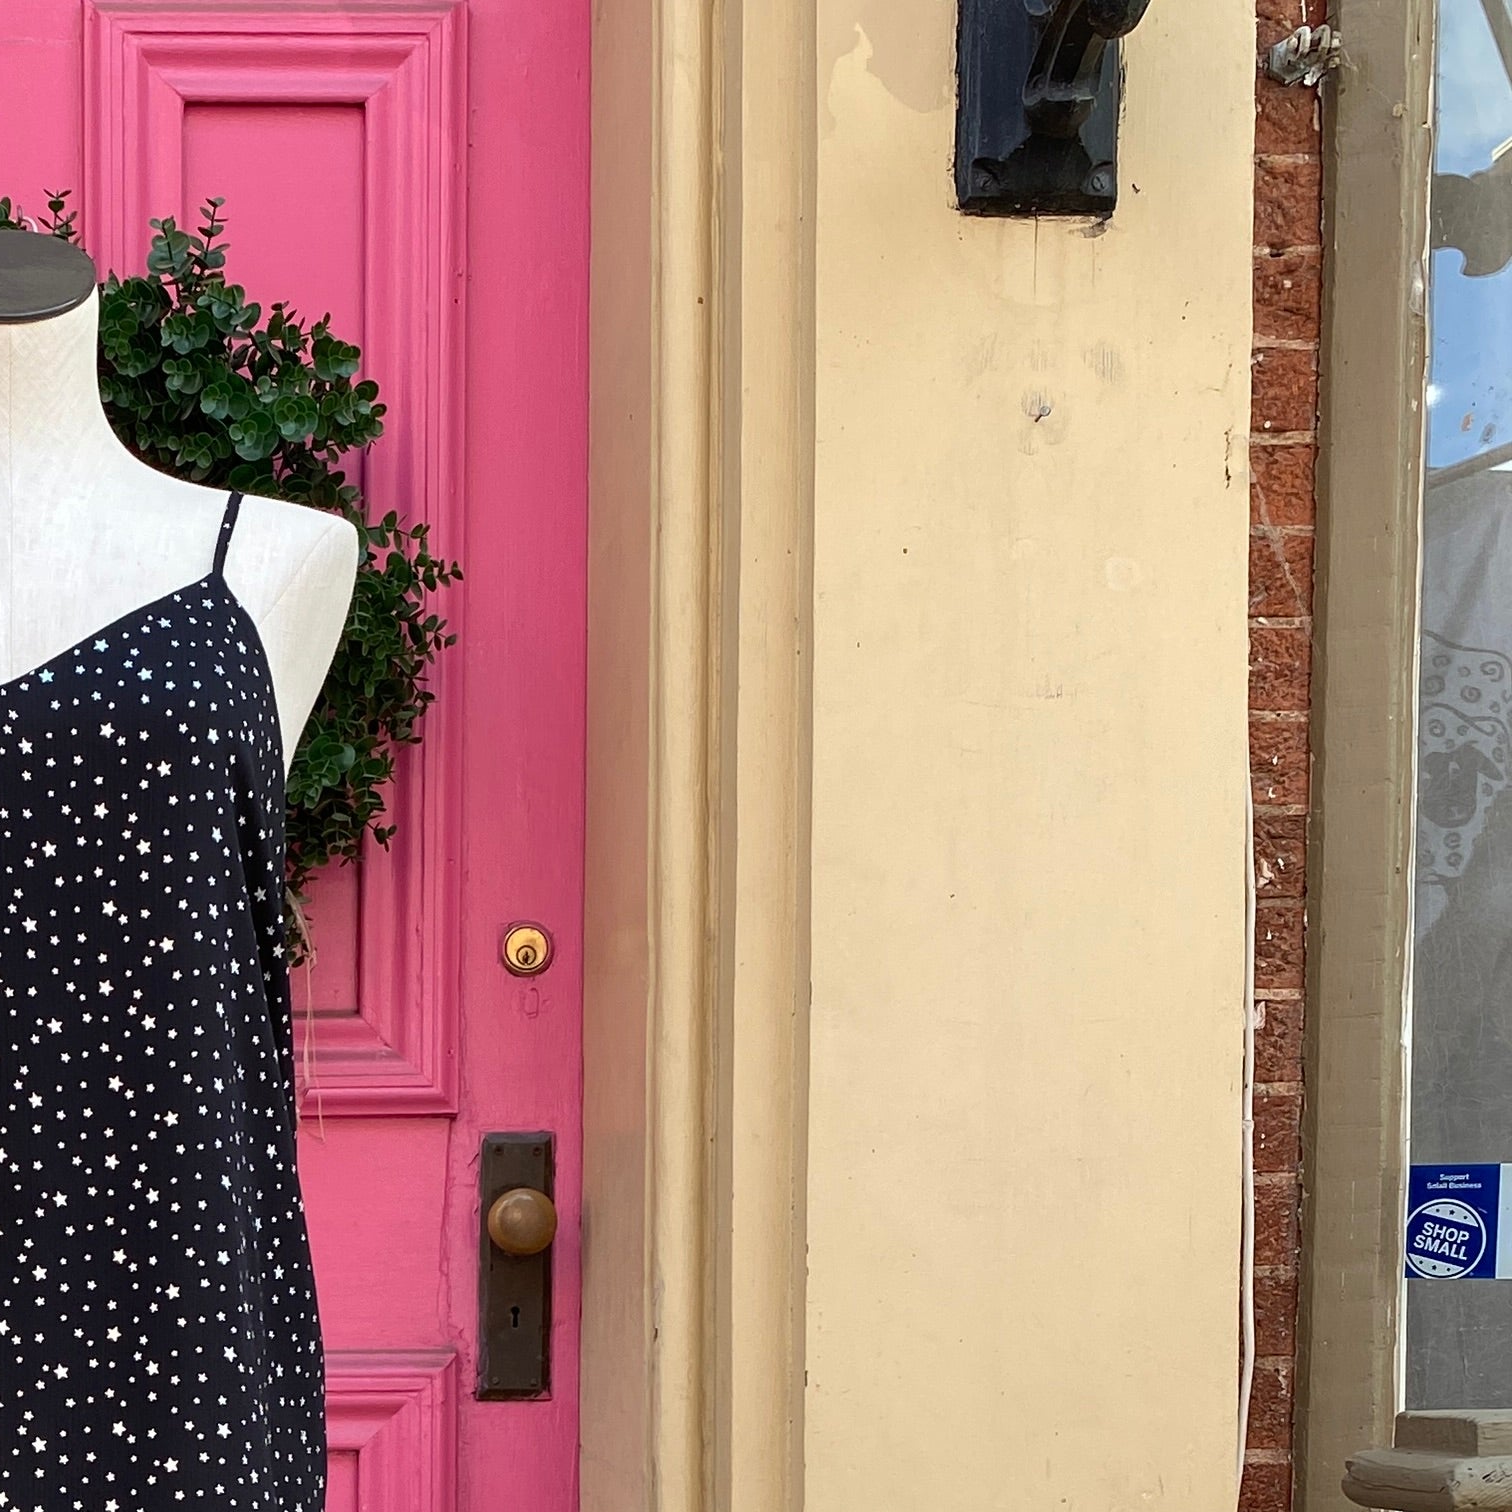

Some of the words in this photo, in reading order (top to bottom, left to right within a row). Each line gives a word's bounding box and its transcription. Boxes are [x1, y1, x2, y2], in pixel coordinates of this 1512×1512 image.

[1439, 1173, 1470, 1182] Support
[1421, 1221, 1470, 1244] SHOP
[1413, 1234, 1468, 1260] SMALL
